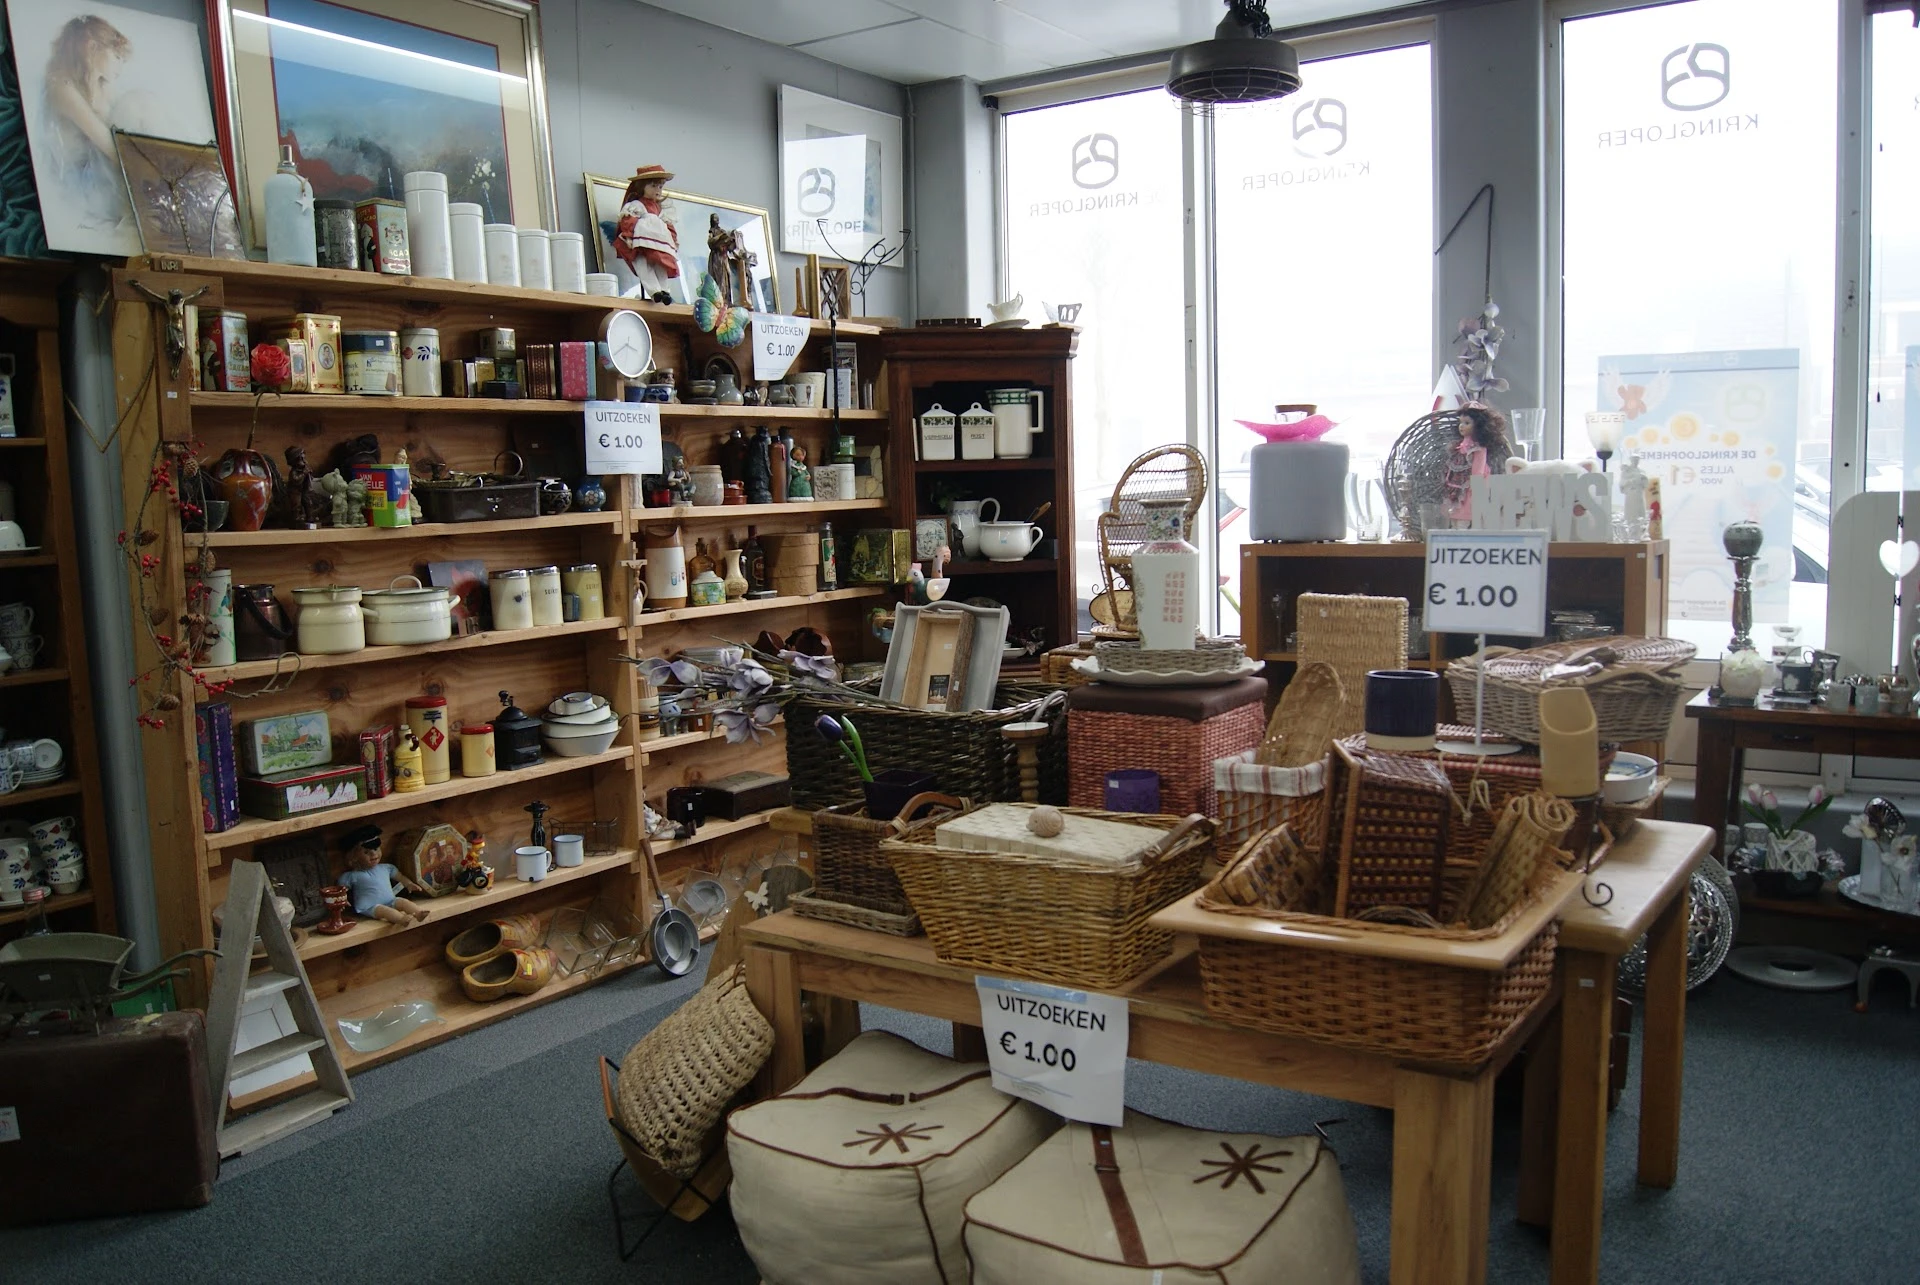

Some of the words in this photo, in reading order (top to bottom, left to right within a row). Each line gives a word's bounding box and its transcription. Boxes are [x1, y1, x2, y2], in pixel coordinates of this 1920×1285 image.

[761, 324, 804, 336] UITZOEKEN
[767, 342, 775, 355] €
[778, 344, 795, 356] 1.00
[595, 411, 651, 424] UITZOEKEN
[598, 433, 610, 448] €
[614, 435, 643, 448] 1.00
[363, 481, 384, 489] ELLE
[1428, 582, 1447, 605] €
[1456, 585, 1518, 607] 1.00
[997, 994, 1106, 1032] UITZOEKEN
[999, 1031, 1017, 1055] €
[1024, 1041, 1076, 1072] 1.00
